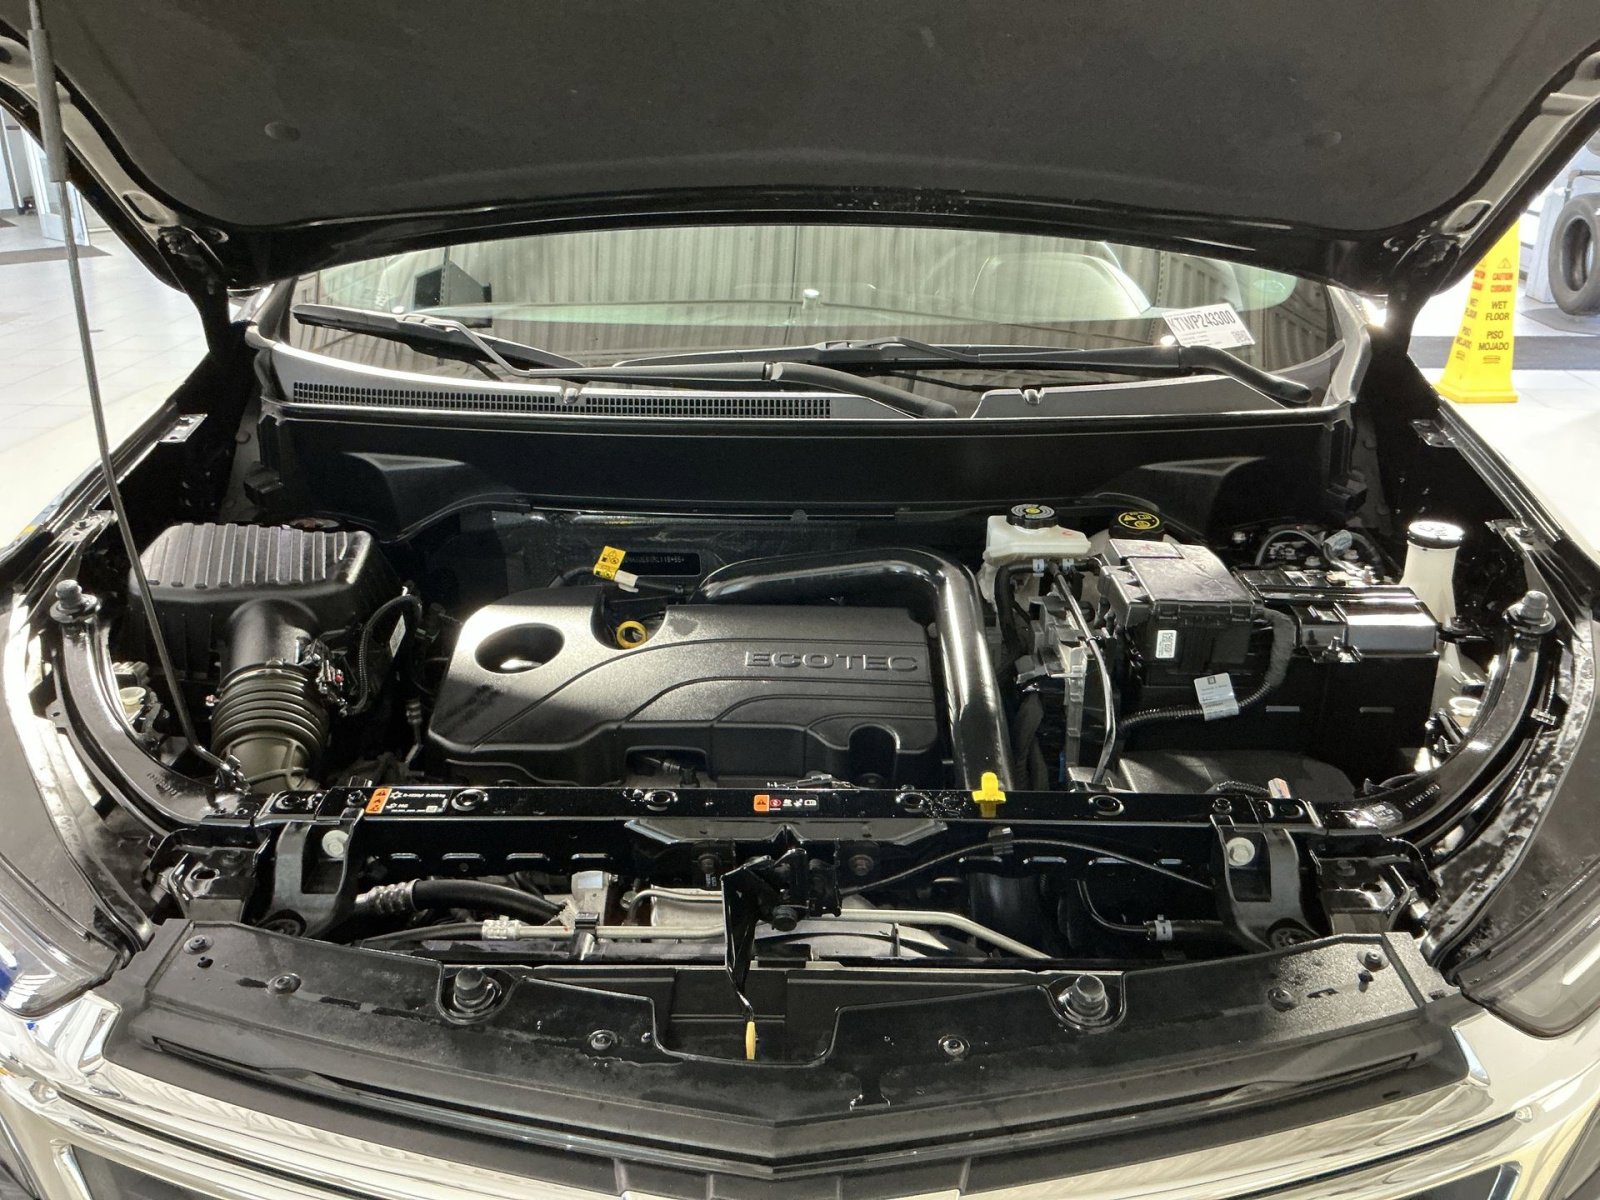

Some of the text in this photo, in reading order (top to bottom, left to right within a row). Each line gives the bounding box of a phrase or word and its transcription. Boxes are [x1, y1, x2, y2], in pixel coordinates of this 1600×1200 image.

[1491, 300, 1508, 309] WET
[1168, 310, 1236, 332] KTWP243300
[1485, 312, 1510, 321] FLOOR
[1486, 330, 1504, 339] PISO
[1478, 341, 1509, 351] MOJADO
[744, 651, 918, 672] ECOTEC
